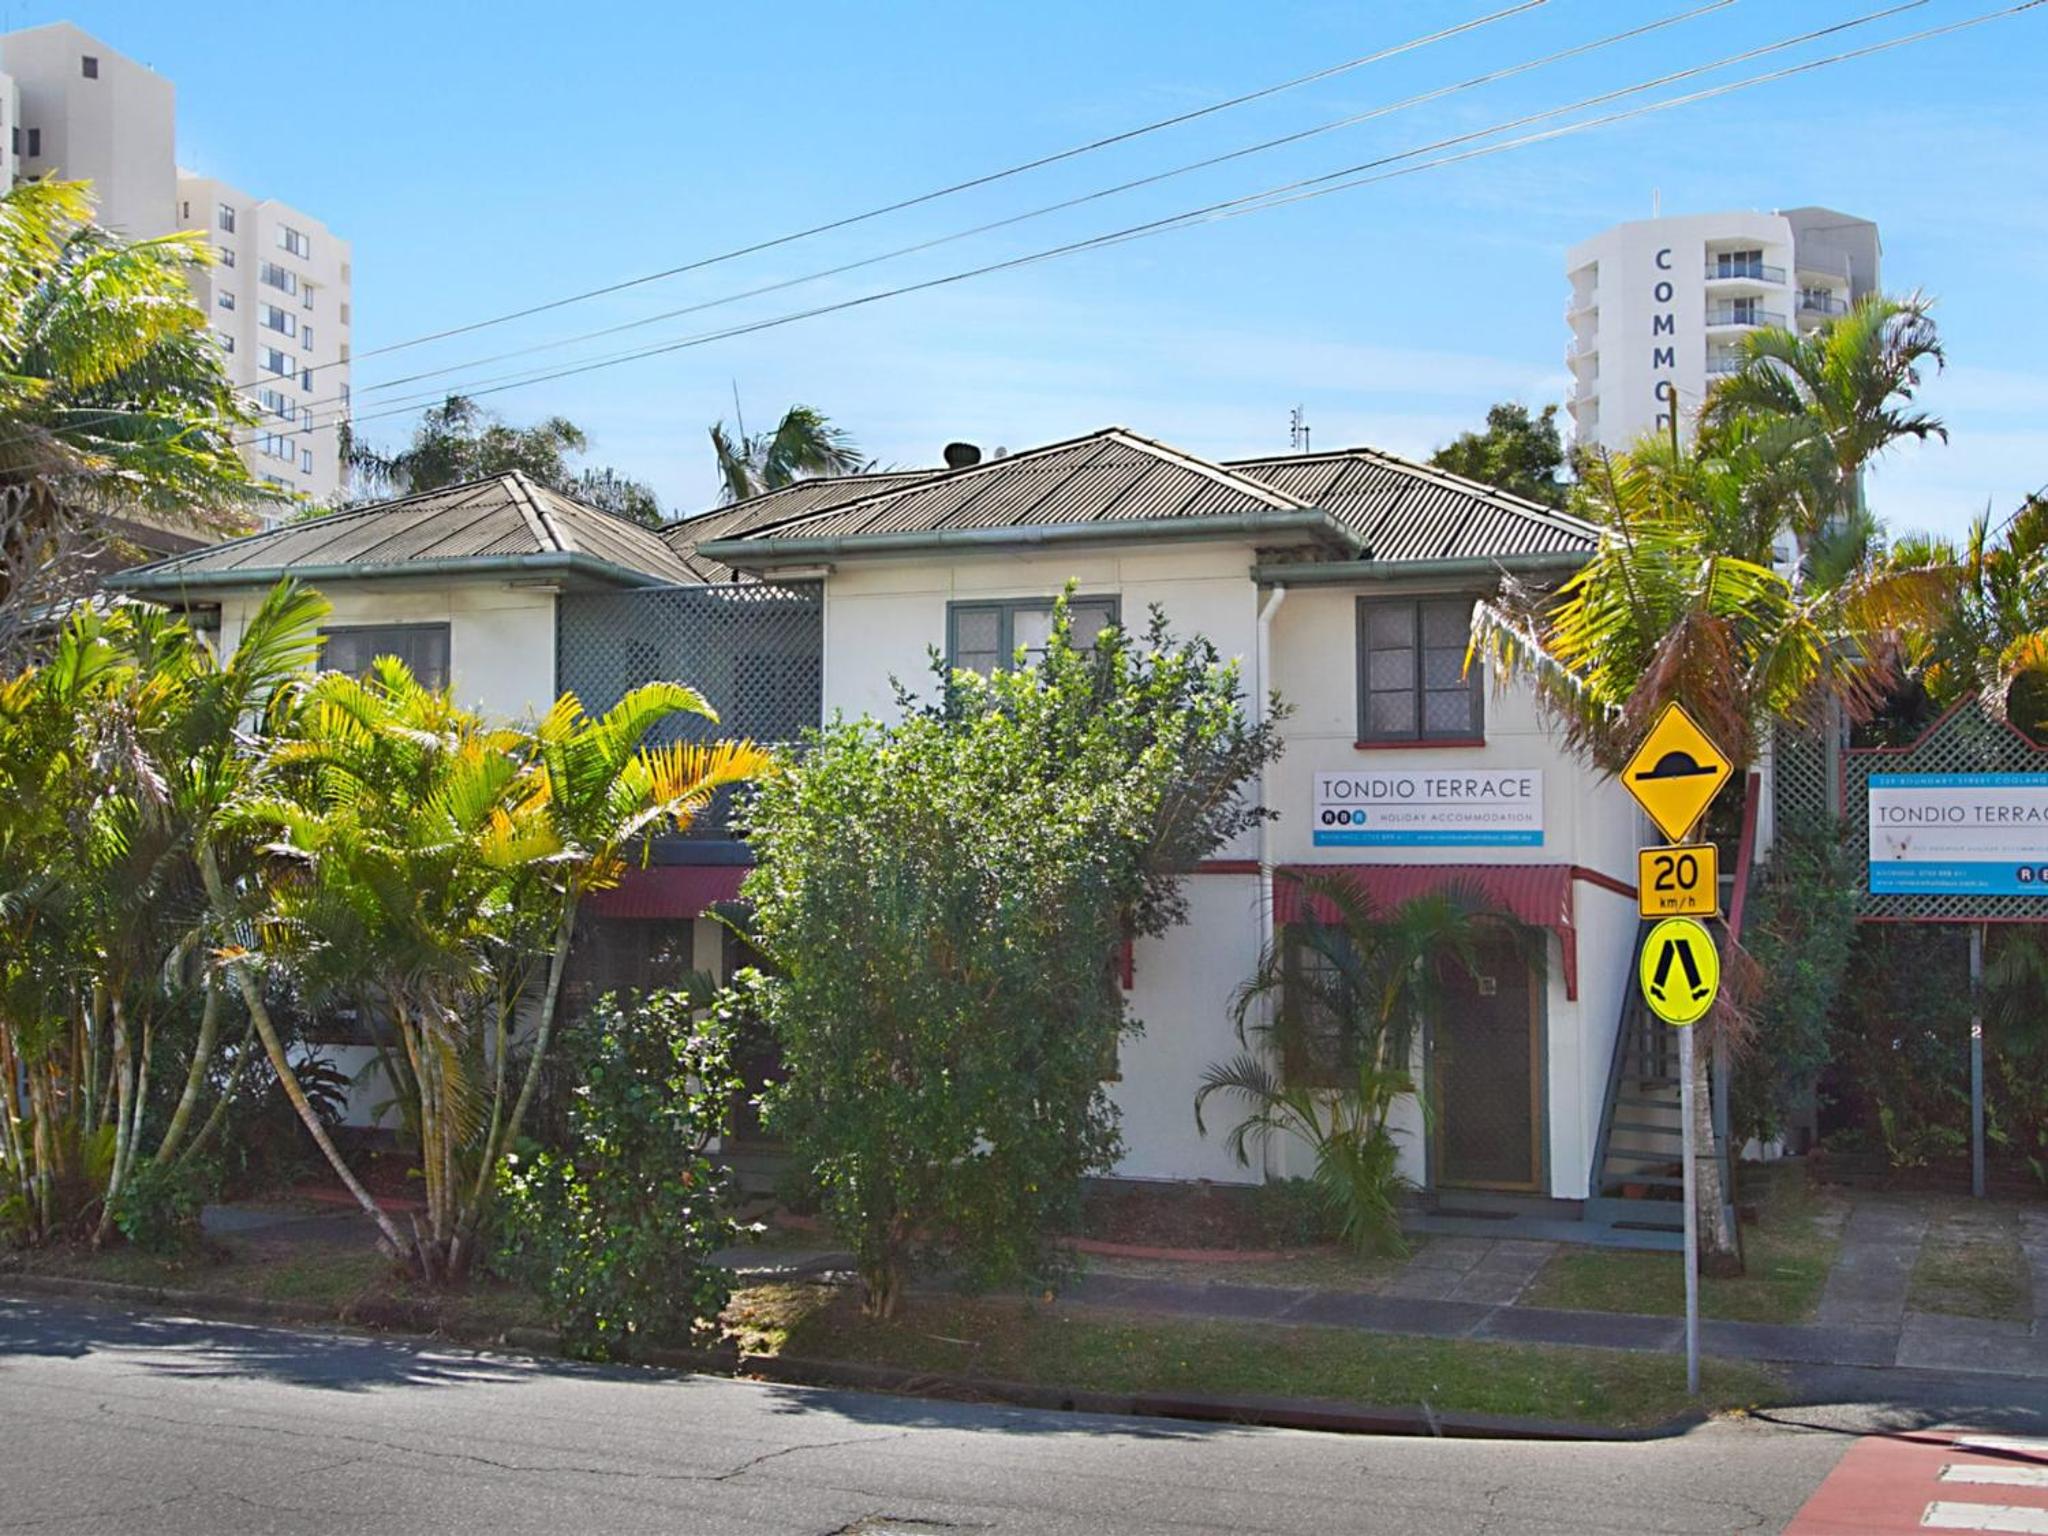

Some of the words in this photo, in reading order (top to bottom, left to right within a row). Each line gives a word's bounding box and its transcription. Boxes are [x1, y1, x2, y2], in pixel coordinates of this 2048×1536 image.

[1322, 779, 1415, 798] TONDIO
[1424, 778, 1532, 798] TERRACE
[1380, 813, 1426, 823] HOLIDAY
[1430, 812, 1533, 823] ACCOMMODATION
[1878, 805, 1965, 823] TONDIO
[1974, 805, 2048, 822] TERRA
[1654, 854, 1698, 891] 20
[1659, 895, 1696, 909] km/h
